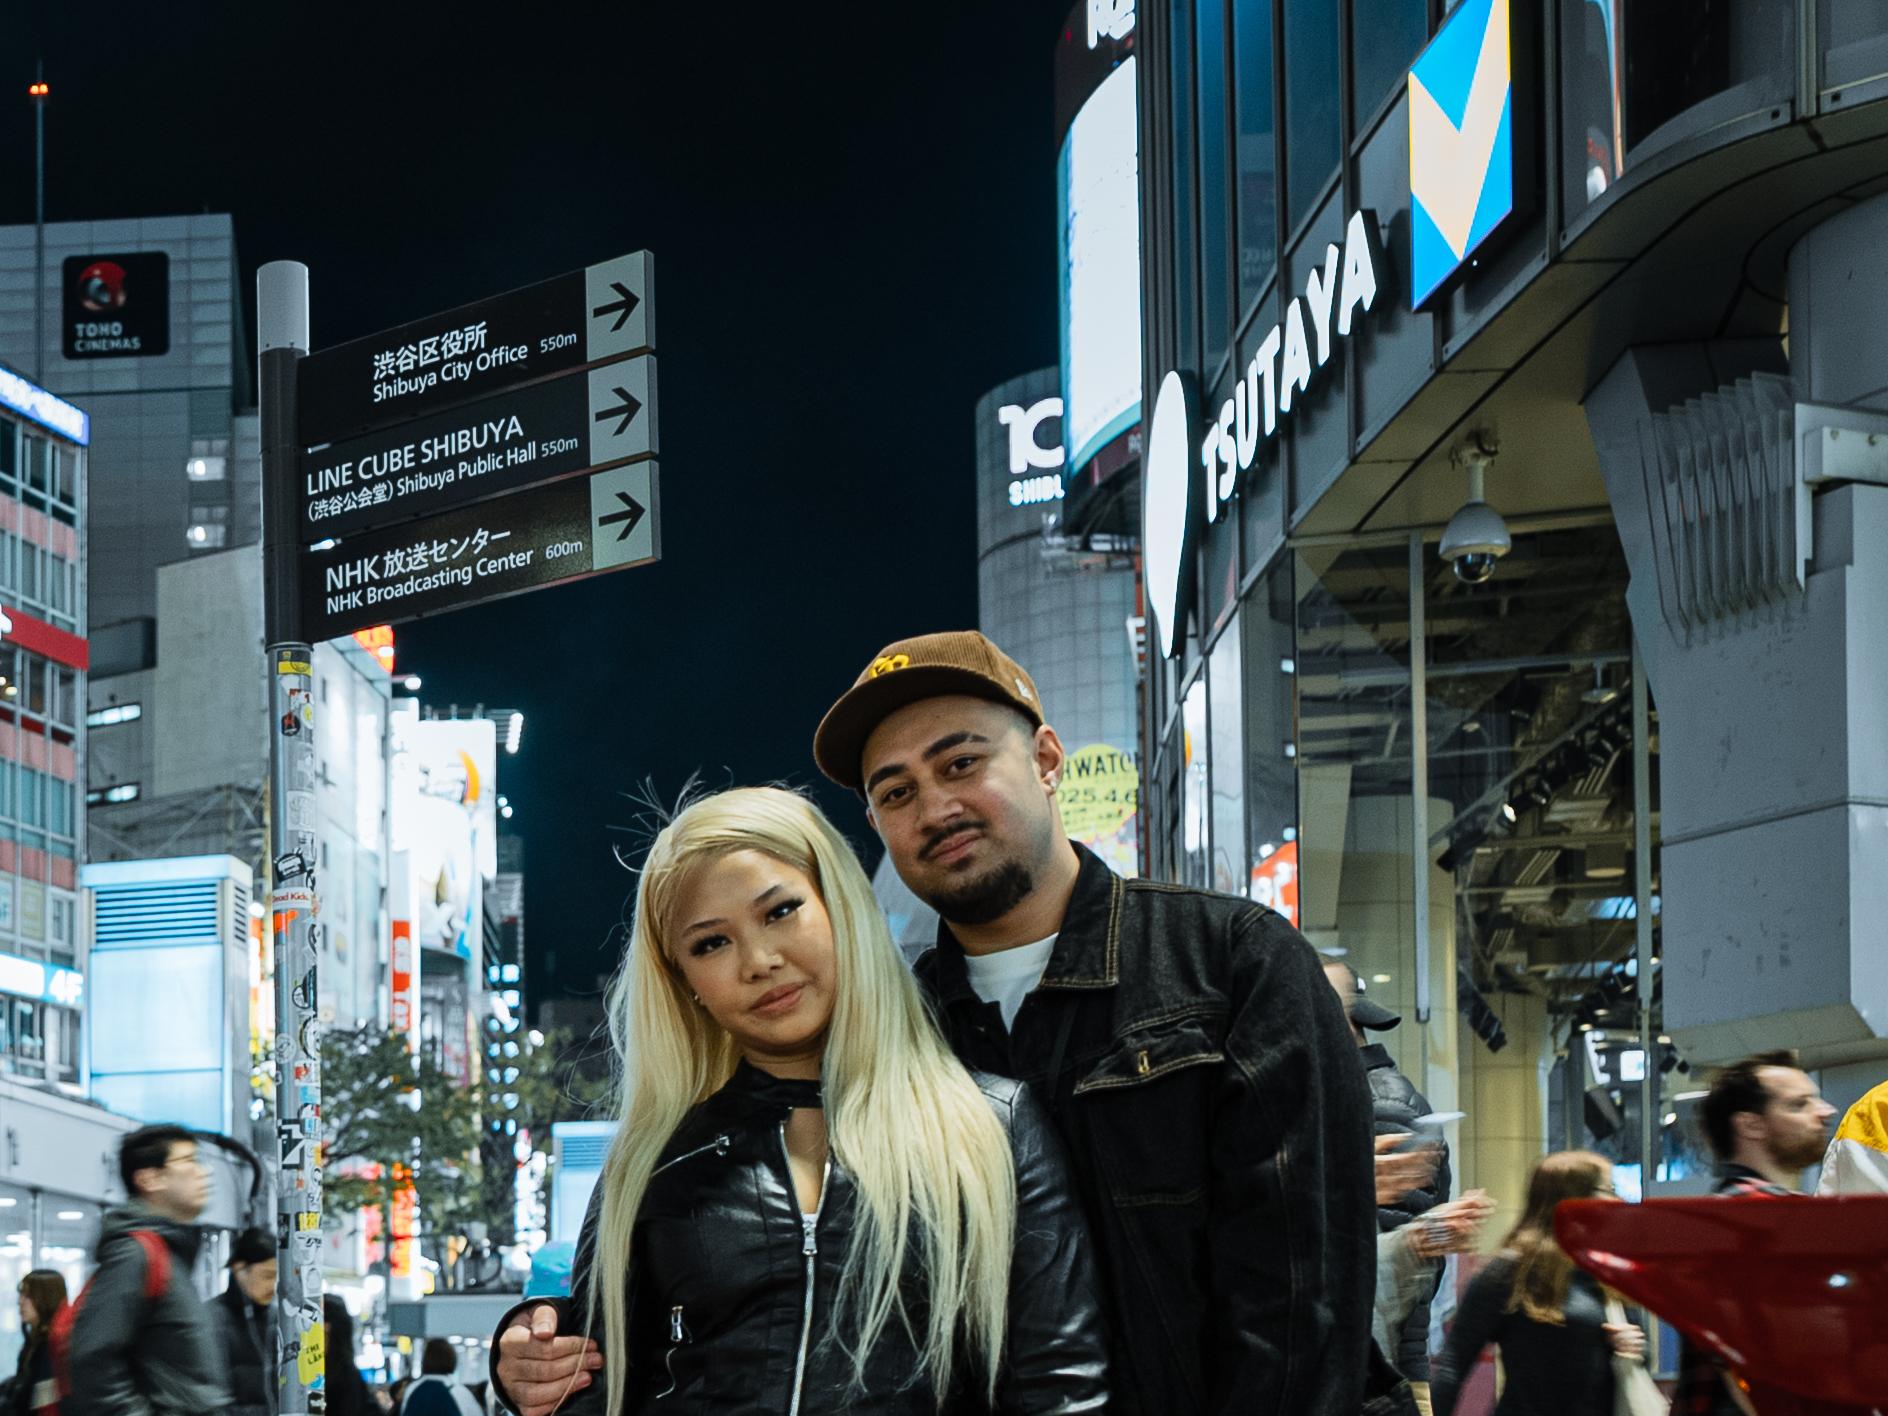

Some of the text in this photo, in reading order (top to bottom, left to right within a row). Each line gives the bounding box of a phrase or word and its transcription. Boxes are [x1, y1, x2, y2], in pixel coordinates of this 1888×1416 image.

[74, 336, 142, 352] CINEMAS
[75, 321, 123, 338] TOHO
[373, 321, 488, 381] 渋谷区役所
[373, 332, 577, 402] Shibuya City Office 550m
[1201, 208, 1377, 522] TSUTAYA
[307, 415, 524, 495] LINE CUBE SHIBUYA
[308, 438, 578, 521] (渋谷公会堂) Shibuya Public Hall 550m
[326, 527, 511, 592] NHK 放送センター
[327, 541, 583, 614] NHK Broadcasting Center 600m
